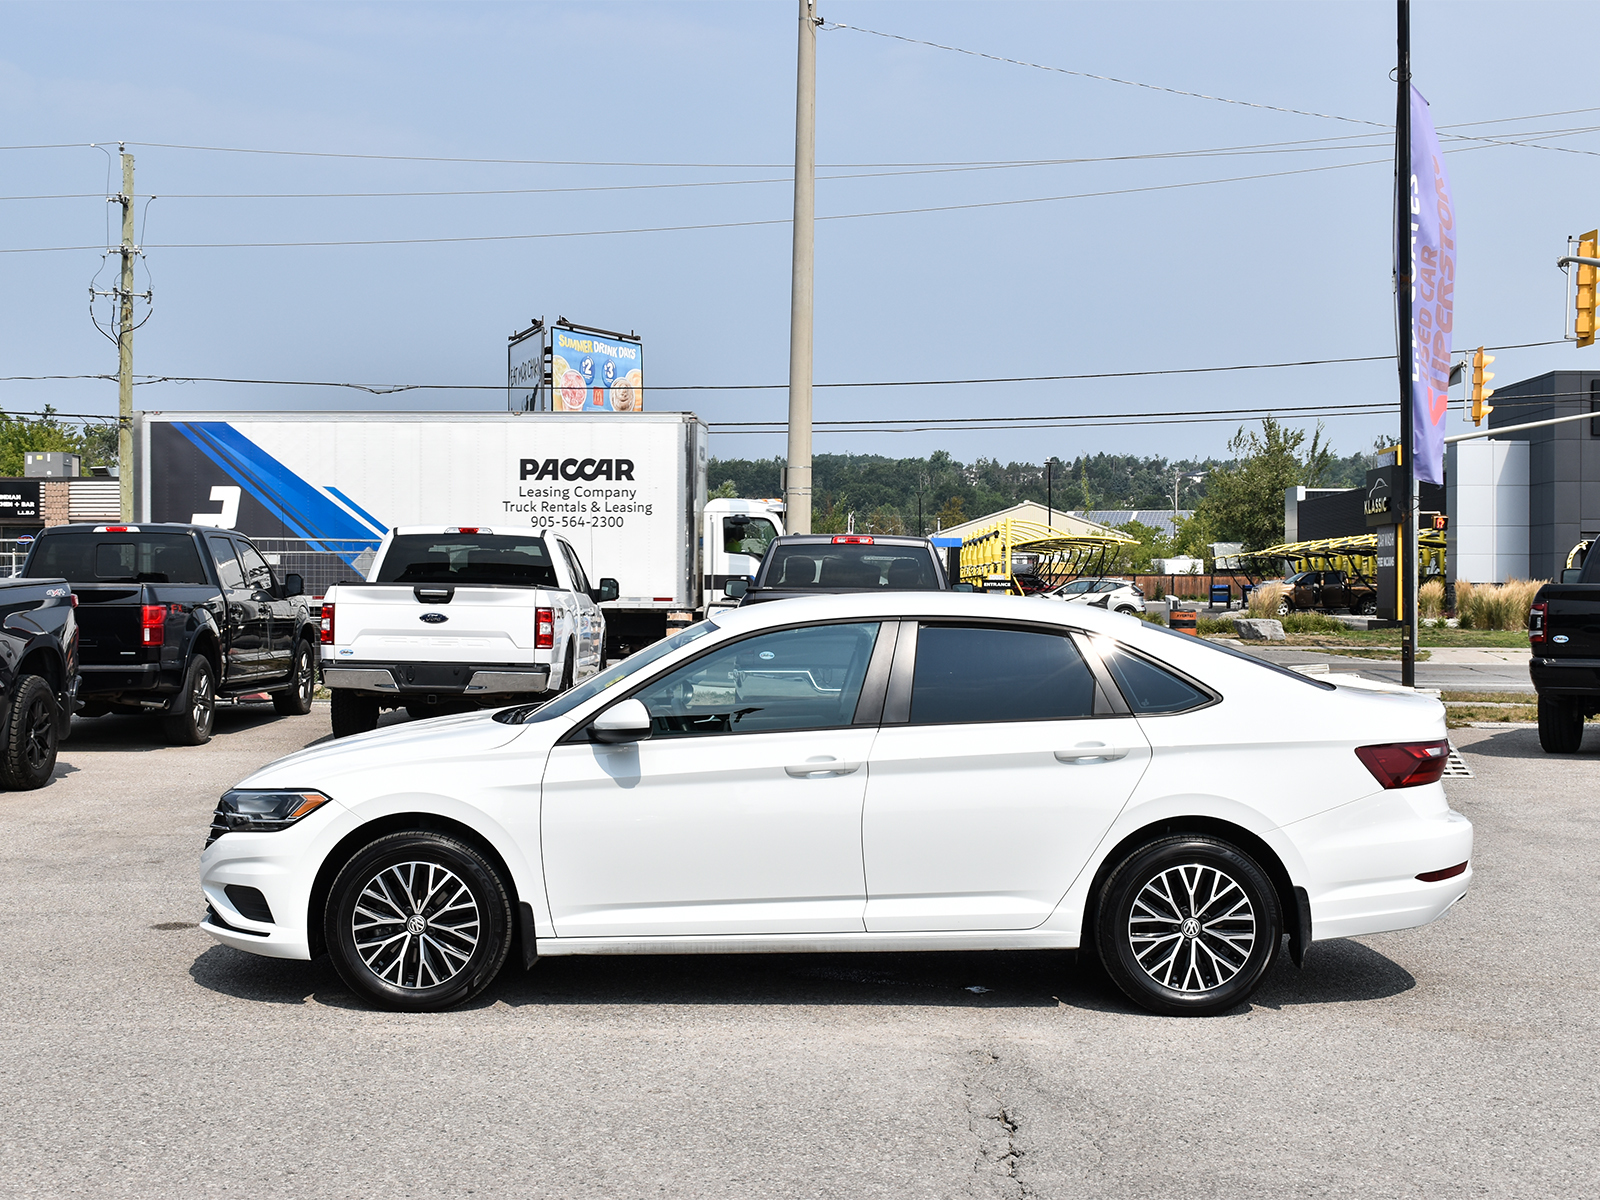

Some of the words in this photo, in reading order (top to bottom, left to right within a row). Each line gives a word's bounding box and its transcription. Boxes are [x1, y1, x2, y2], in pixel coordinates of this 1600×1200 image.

[1421, 245, 1438, 302] CAR
[558, 334, 594, 354] SUMMER
[593, 341, 618, 358] DRINK
[618, 346, 636, 360] DAYS
[1418, 307, 1431, 381] USED
[519, 458, 635, 481] PACCAR
[518, 486, 570, 500] Leasing
[574, 486, 637, 500] Company
[502, 501, 537, 512] Truck
[541, 501, 588, 512] Rentals
[590, 501, 601, 512] &
[605, 501, 653, 515] Leasing
[1364, 496, 1388, 515] KLASSIC
[530, 516, 624, 528] 905-564-2300
